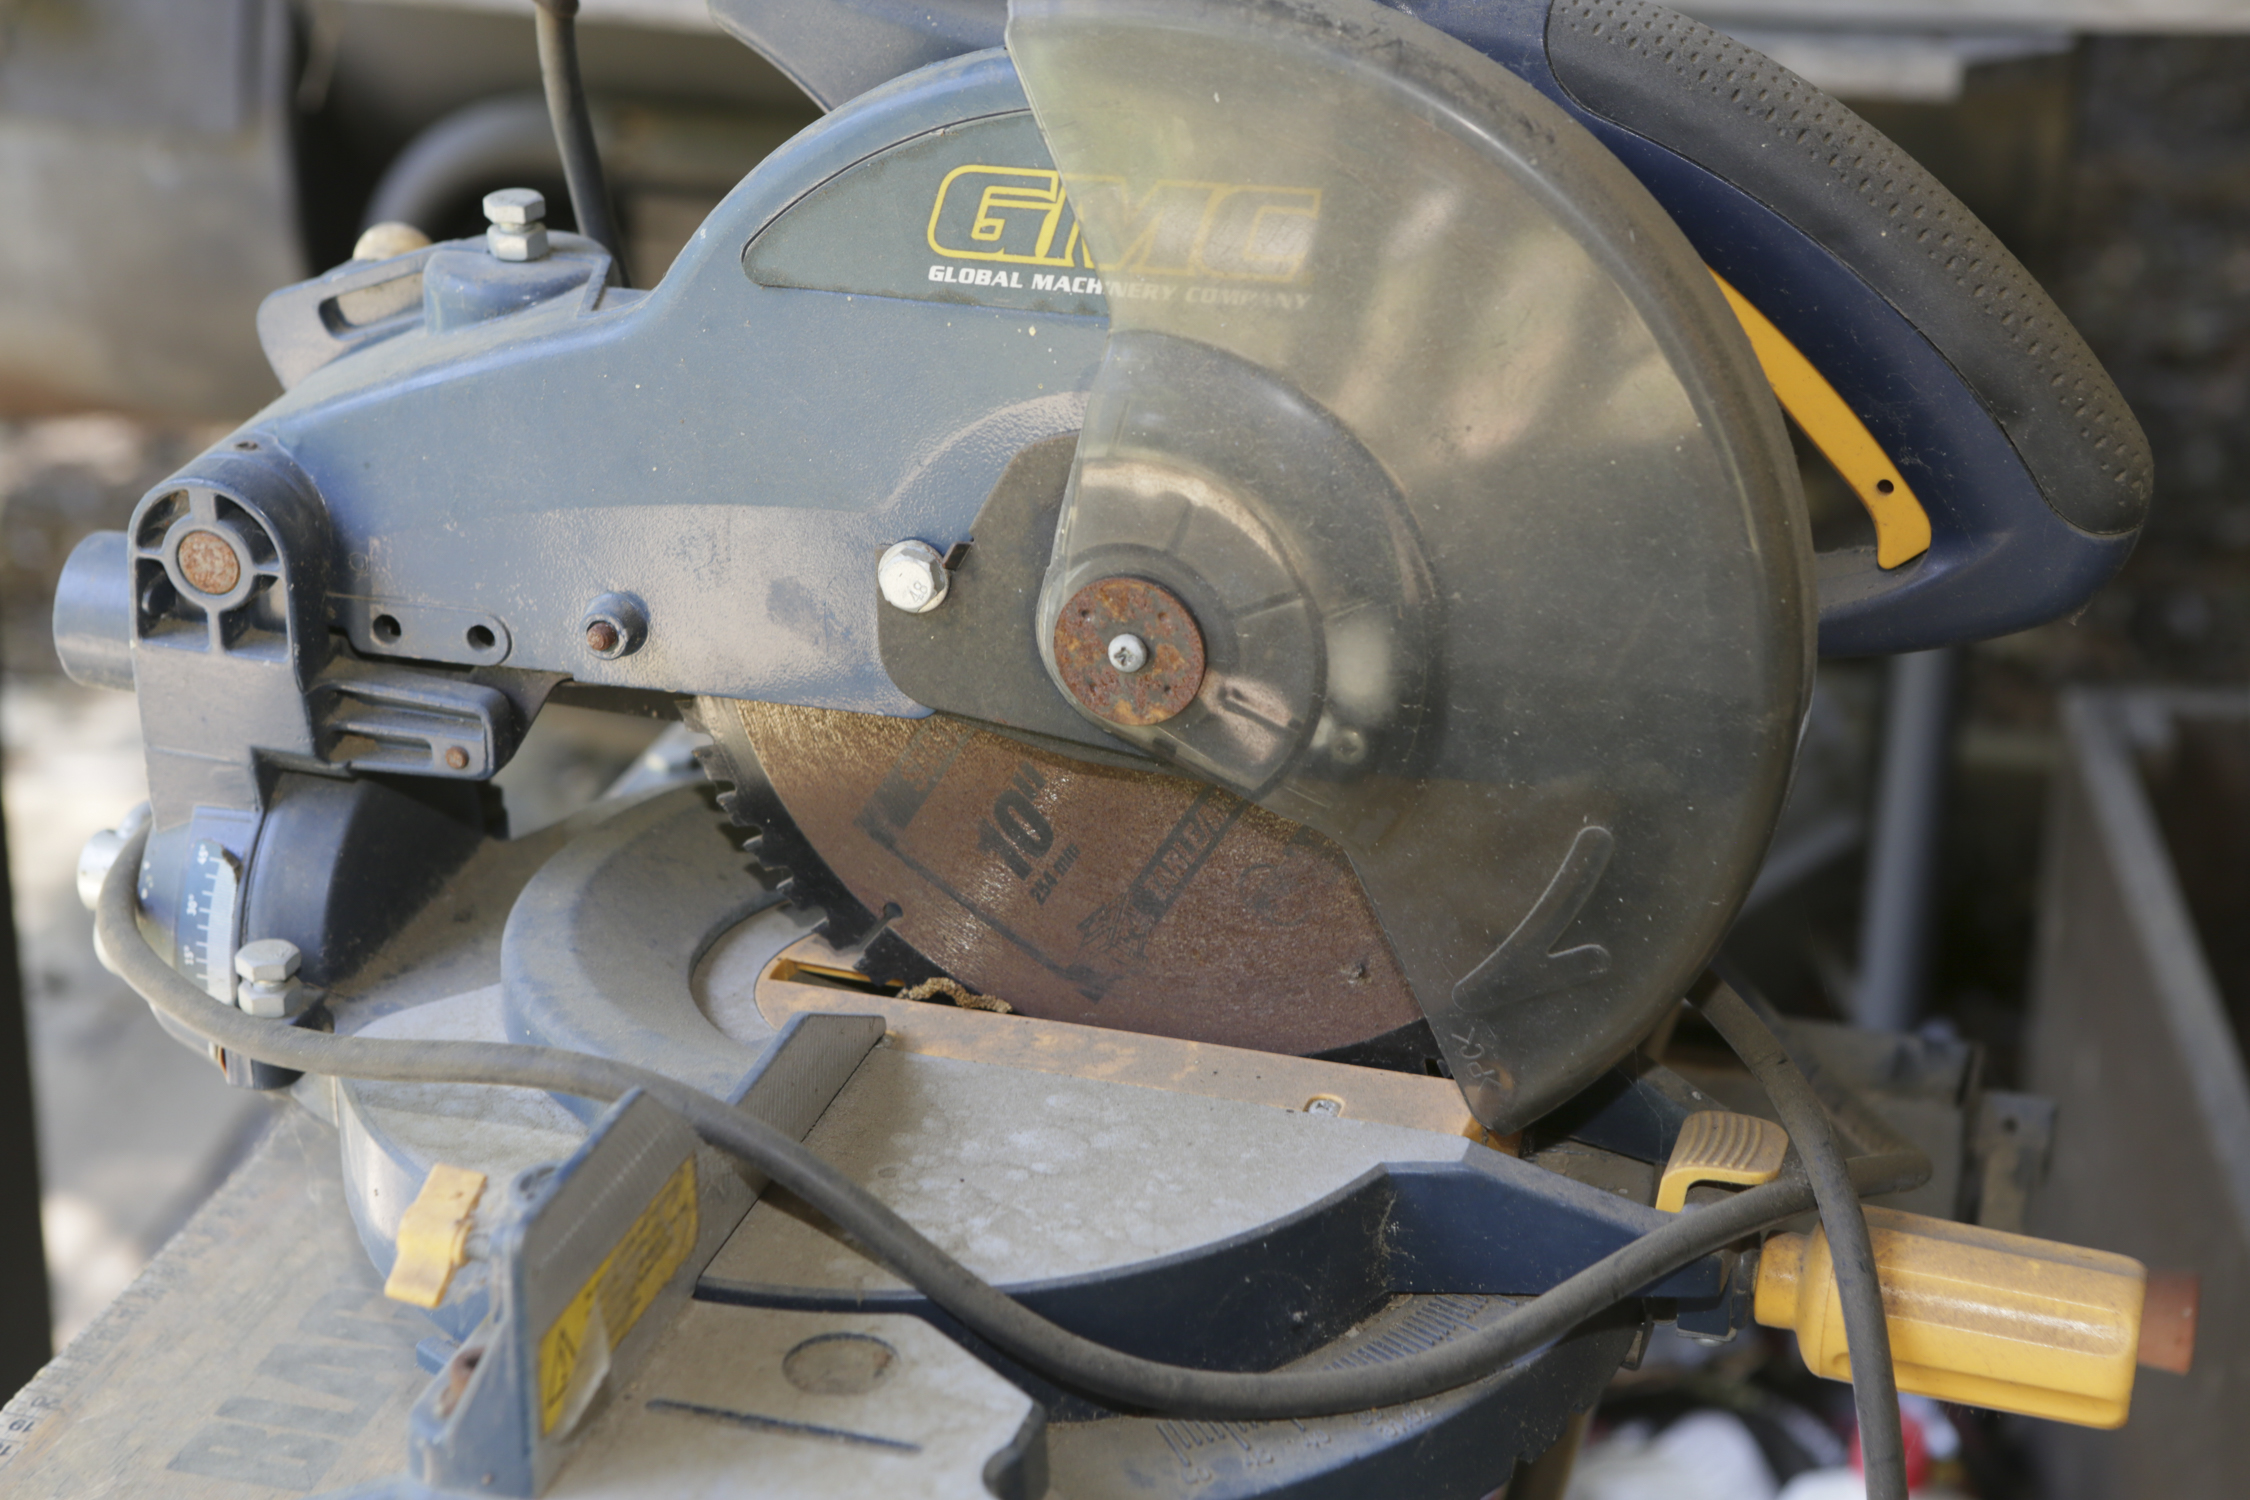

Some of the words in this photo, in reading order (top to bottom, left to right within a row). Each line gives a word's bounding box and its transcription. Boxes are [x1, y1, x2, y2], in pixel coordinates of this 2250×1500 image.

[927, 164, 1322, 282] GMC
[928, 265, 1024, 290] GLOBAL
[1031, 273, 1177, 302] MACHINERY
[1029, 871, 1058, 906] 254
[1053, 843, 1081, 877] mm
